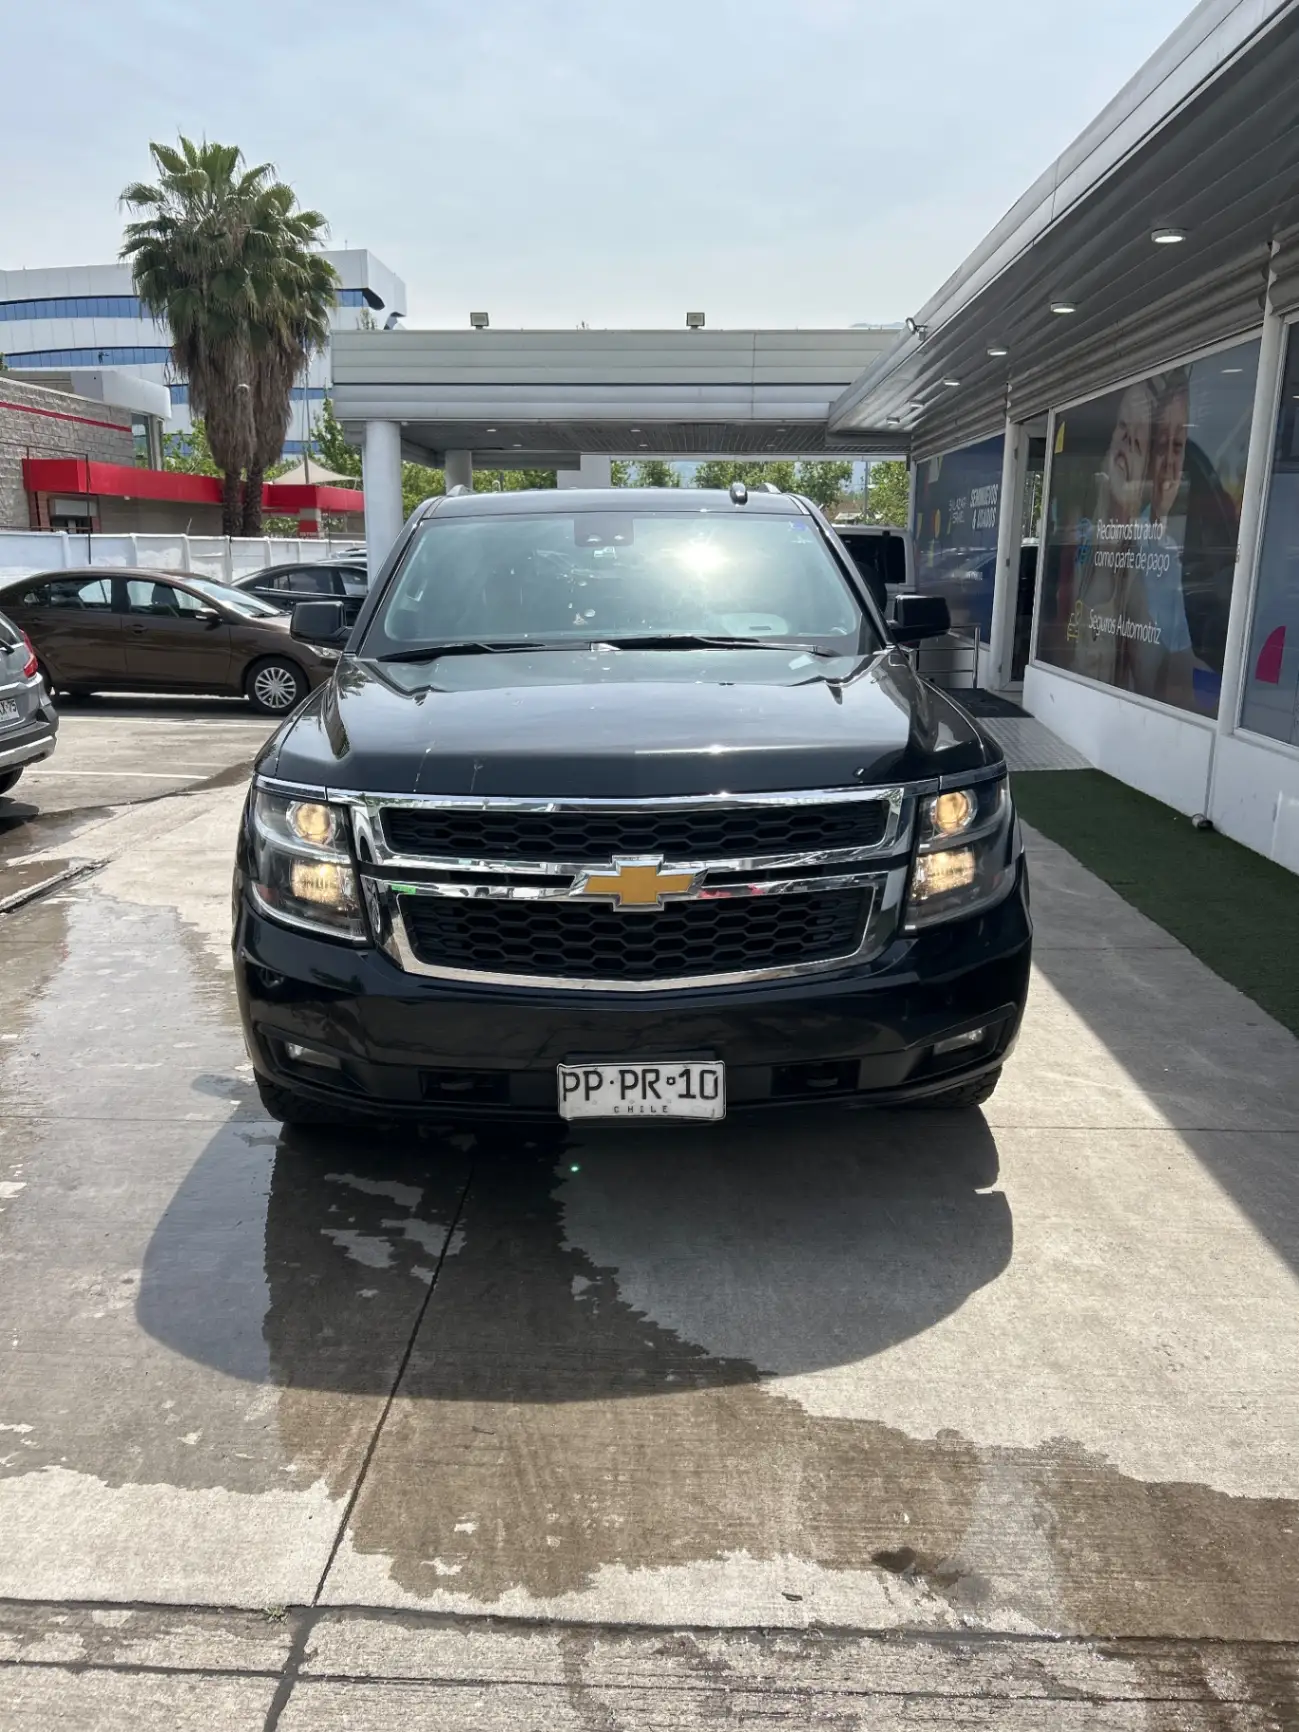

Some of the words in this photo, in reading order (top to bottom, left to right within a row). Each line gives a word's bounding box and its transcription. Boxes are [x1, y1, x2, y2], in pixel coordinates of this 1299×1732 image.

[1096, 518, 1133, 541] Recibimos
[1134, 519, 1143, 541] tu
[1143, 519, 1163, 541] auto
[1094, 551, 1114, 569] como
[1113, 548, 1135, 575] parte
[1135, 545, 1146, 570] de
[1145, 552, 1170, 578] pago
[1088, 608, 1117, 636] Seguros
[1115, 614, 1162, 645] Automotriz
[613, 1105, 669, 1114] CHILE
